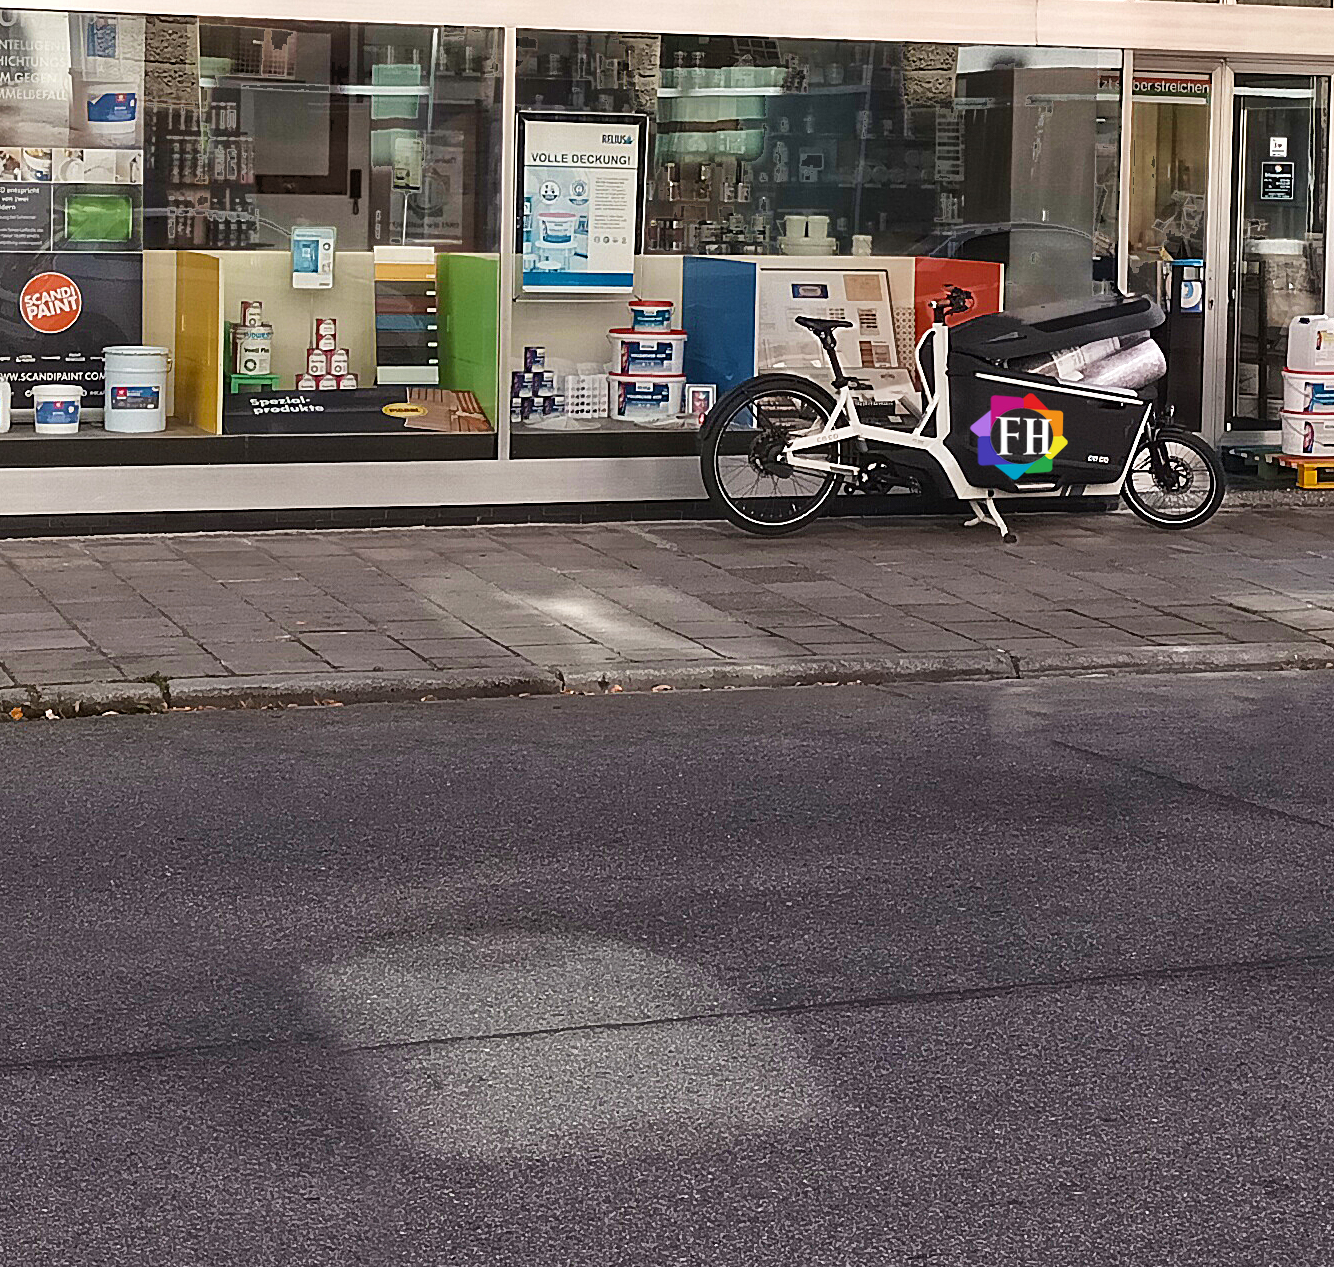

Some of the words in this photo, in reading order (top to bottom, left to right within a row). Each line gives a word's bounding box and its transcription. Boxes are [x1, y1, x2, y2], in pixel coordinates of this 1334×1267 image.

[531, 152, 569, 164] VOLLE
[571, 154, 631, 166] DECKUNG!
[24, 285, 77, 308] SCANDI
[27, 295, 78, 321] PAINT
[253, 404, 325, 415] produkte
[995, 415, 1053, 457] FH
